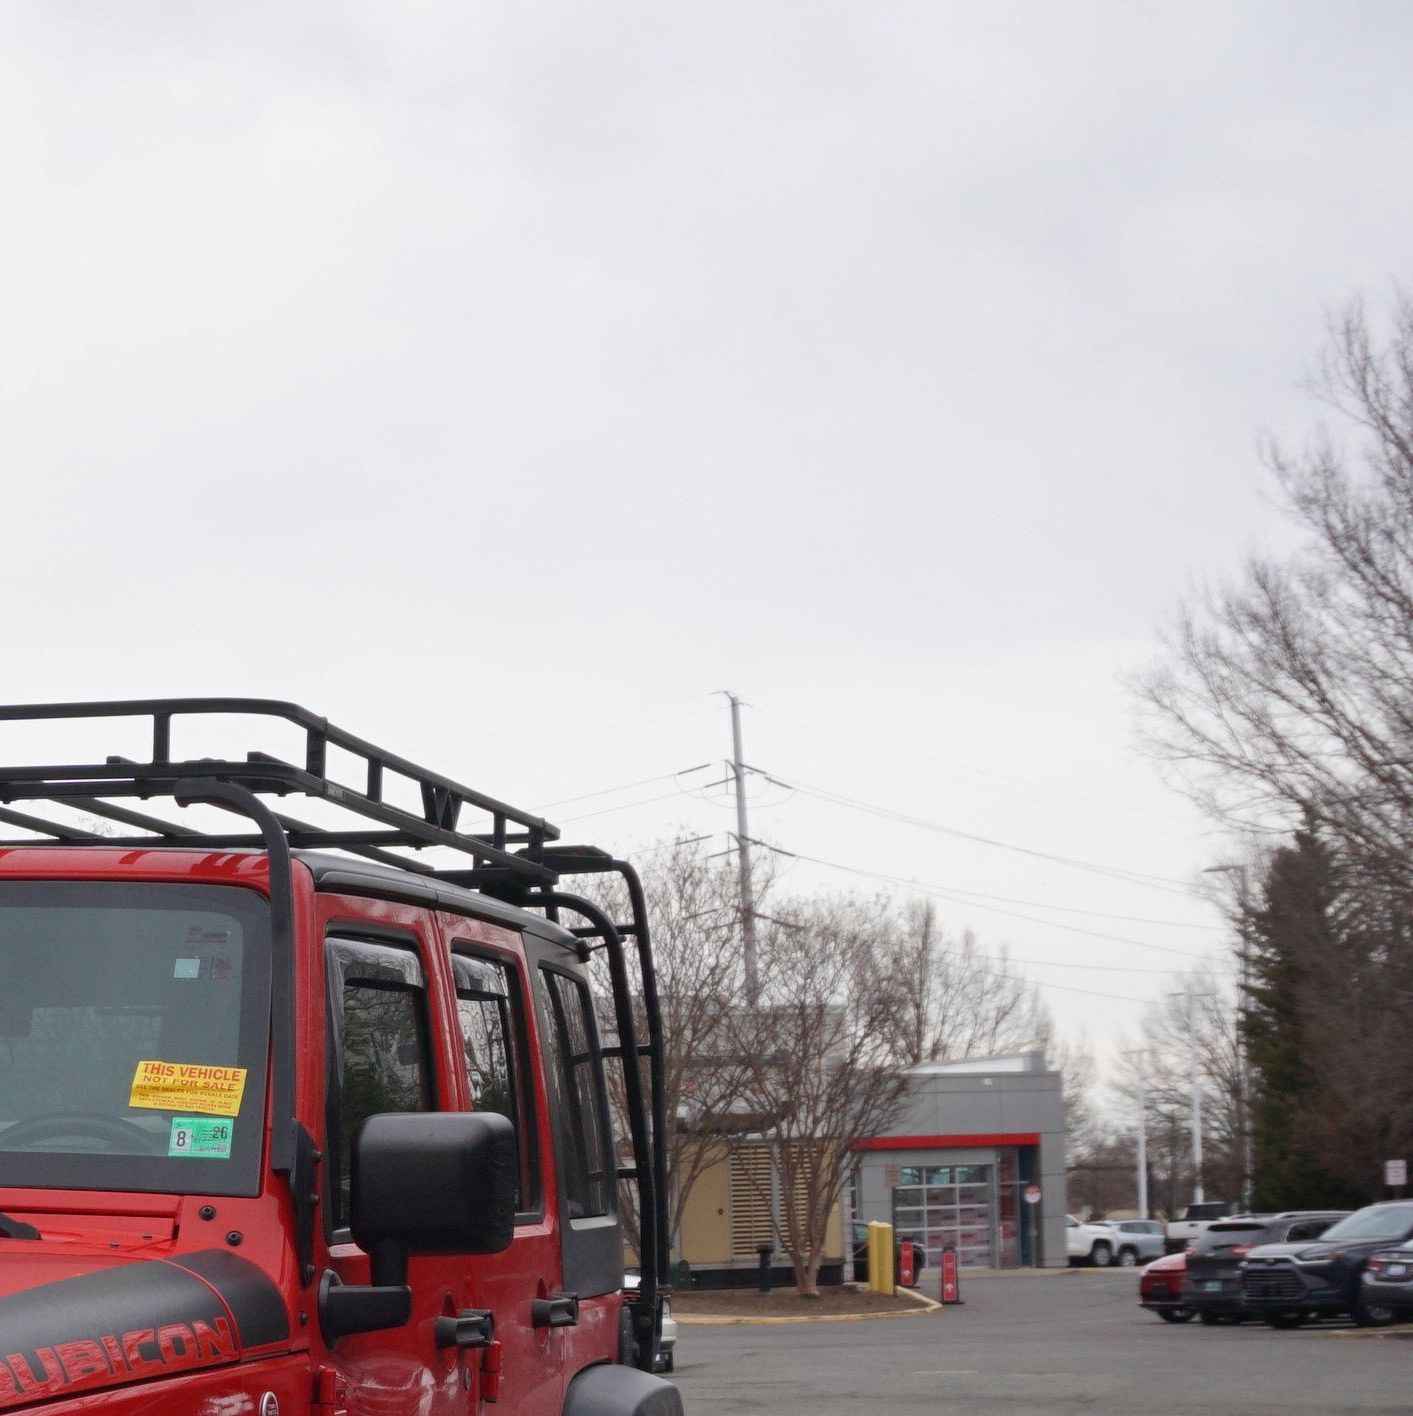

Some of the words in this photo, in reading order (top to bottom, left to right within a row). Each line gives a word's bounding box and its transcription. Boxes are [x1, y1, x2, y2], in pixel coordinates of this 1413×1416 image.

[143, 1063, 175, 1077] THIS
[179, 1066, 242, 1082] VEHICLE
[143, 1075, 167, 1084] NOT
[172, 1078, 199, 1088] FOR
[202, 1081, 237, 1092] SALE
[176, 1130, 187, 1147] 8
